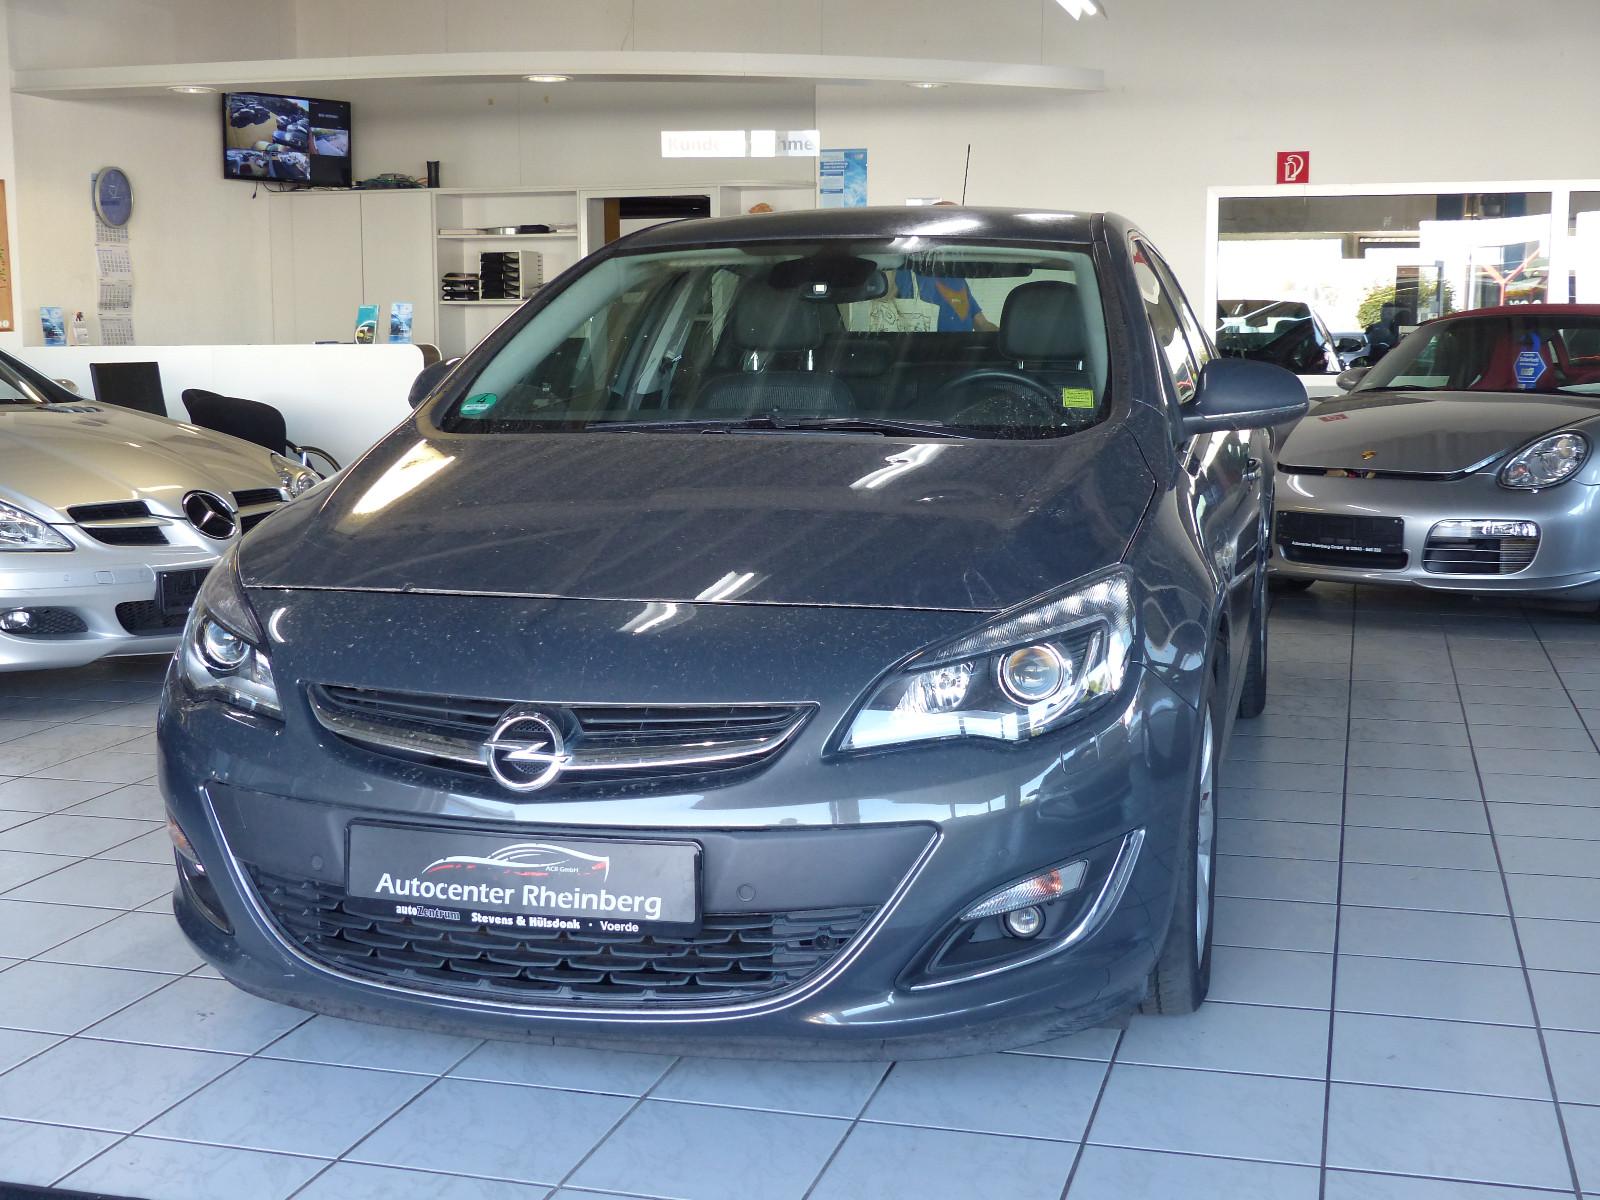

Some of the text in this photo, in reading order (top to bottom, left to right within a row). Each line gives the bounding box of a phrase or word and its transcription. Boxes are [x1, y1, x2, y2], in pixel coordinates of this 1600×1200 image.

[375, 872, 662, 920] Autocenter Rheinberg
[396, 905, 640, 933] autoZentrum Stevens & Hülsdonk Voerde
